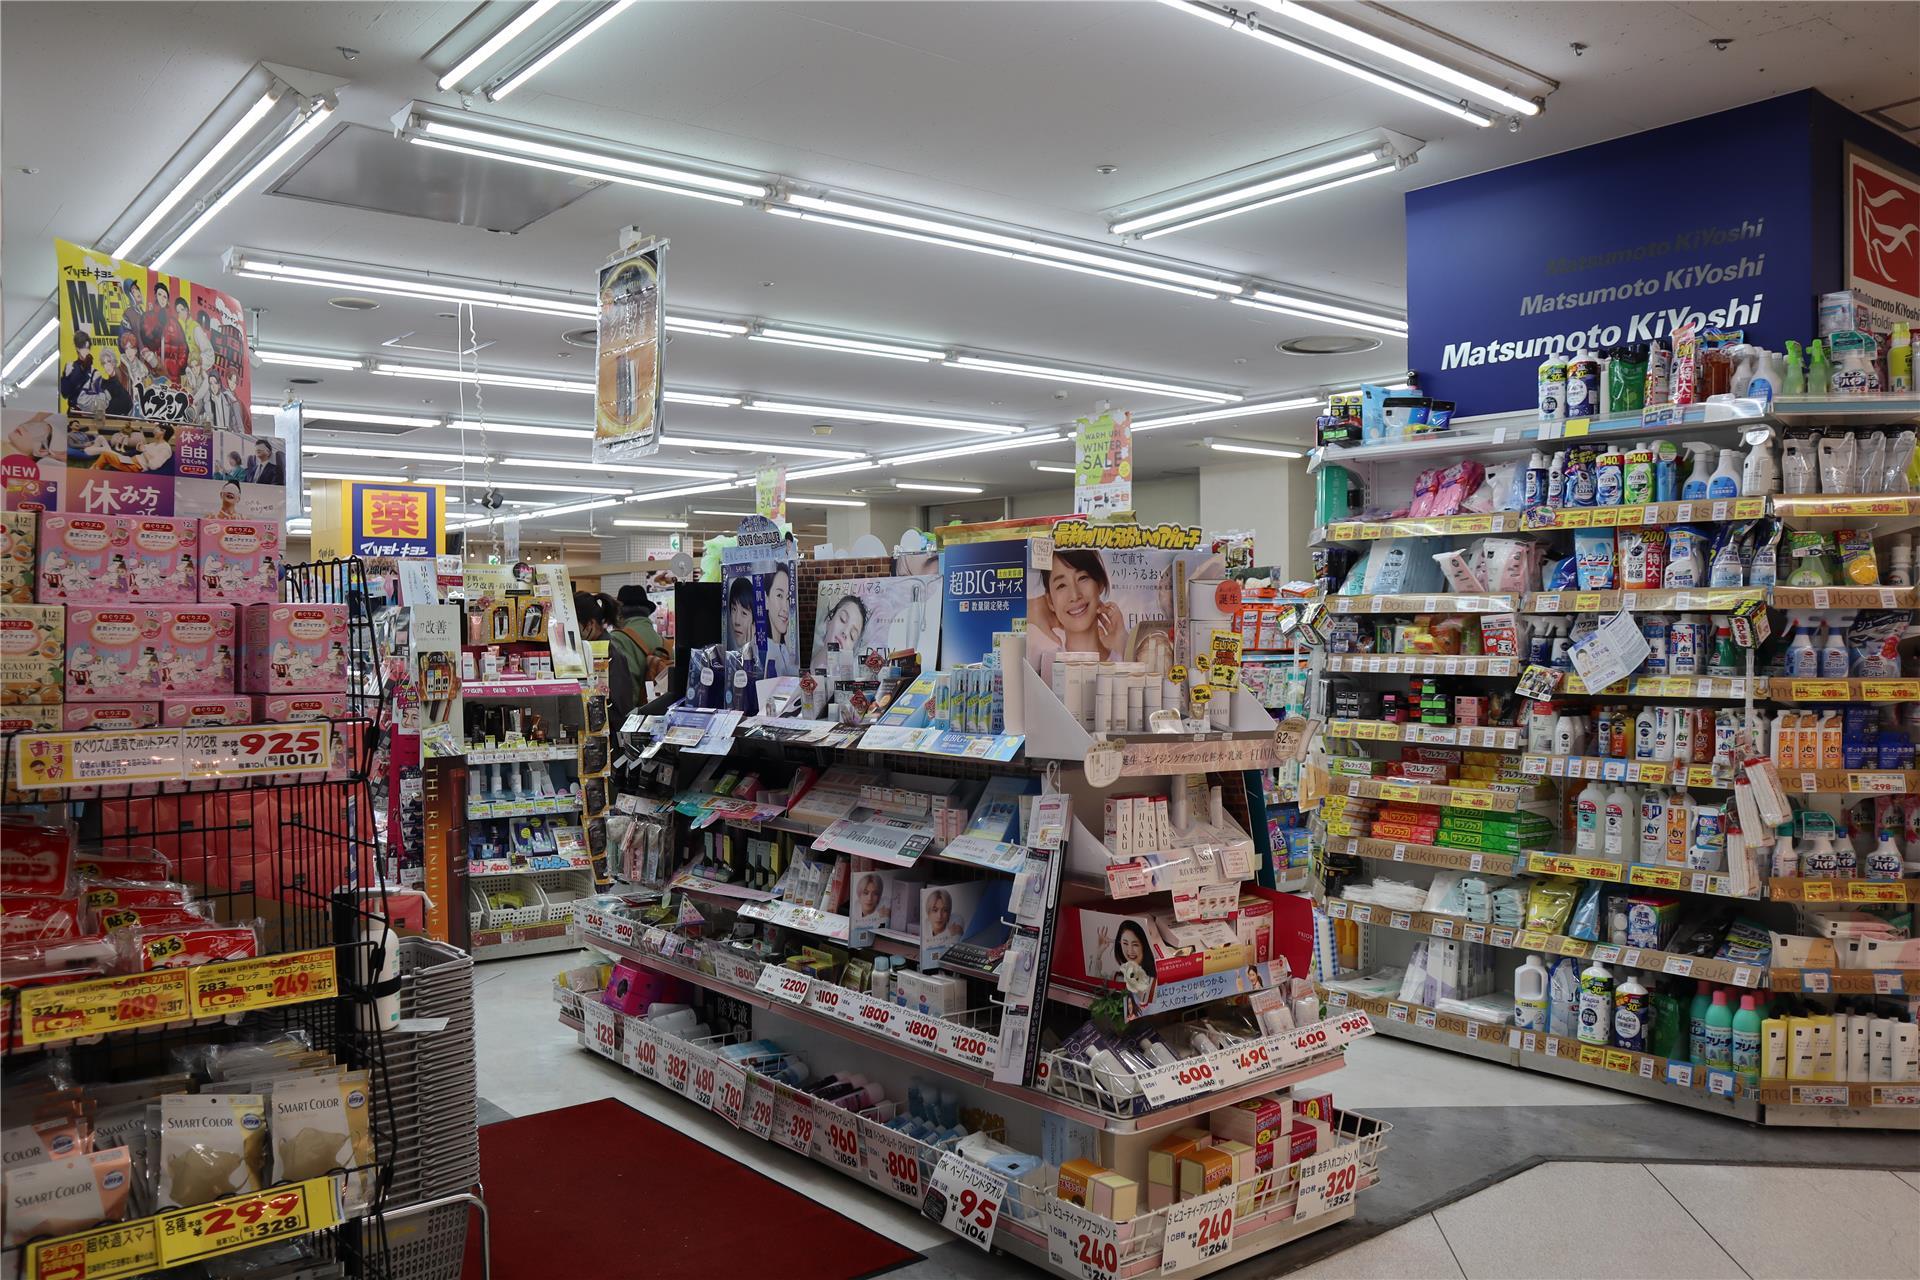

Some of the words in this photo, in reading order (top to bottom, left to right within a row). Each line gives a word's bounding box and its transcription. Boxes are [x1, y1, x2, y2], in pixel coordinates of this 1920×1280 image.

[1675, 217, 1764, 252] KiYoshi
[1520, 277, 1660, 317] Matsumoto
[1664, 254, 1766, 293] KiYoshi
[1441, 323, 1622, 372] Matsumoto
[1626, 294, 1764, 344] KiYoshi
[180, 446, 208, 460] 自由
[1084, 440, 1122, 453] WINTER
[1083, 452, 1122, 470] SALE
[1, 465, 38, 478] NEW
[80, 479, 160, 514] 休み方
[371, 492, 420, 536] 薬
[73, 521, 103, 530] めぐりズム
[143, 522, 172, 530] めぐりズム
[1643, 530, 1665, 544] 200
[360, 542, 428, 558] マツモトキヨシ
[1647, 552, 1660, 578] 特大
[101, 613, 132, 622] めぐりズム
[180, 614, 208, 622] めぐりズム
[296, 611, 322, 619] めぐりズム
[240, 731, 320, 756] 925
[426, 767, 439, 802] THE
[1384, 827, 1410, 836] サランラップ
[1456, 821, 1482, 830] サランラップ
[1643, 825, 1660, 836] JOY
[1668, 830, 1684, 840] JOY
[847, 830, 898, 850] Primavista
[1452, 834, 1481, 844] サランラップ
[108, 913, 136, 927] 貼る
[588, 914, 603, 927] 245
[618, 925, 633, 938] 800
[152, 938, 182, 957] 貼る
[270, 962, 332, 976] ホカロン貼るミニ
[736, 966, 754, 981] 1800
[199, 982, 228, 993] 283
[274, 972, 309, 998] 249
[783, 978, 808, 995] 2200
[118, 994, 158, 1020] 289
[818, 990, 839, 1006] 1100
[1160, 988, 1224, 1009] 大人のオールインワン
[33, 1005, 64, 1016] 327
[863, 1004, 890, 1024] 1800
[597, 1022, 614, 1046] 128
[908, 1020, 938, 1042] 1800
[1342, 1016, 1369, 1034] 980
[956, 1035, 986, 1057] 1200
[1298, 1030, 1326, 1050] 400
[638, 1040, 656, 1066] 400
[1241, 1046, 1269, 1068] 490
[668, 1054, 688, 1082] 382
[1178, 1064, 1213, 1086] 600
[696, 1066, 715, 1094] 480
[278, 1102, 308, 1115] SMART
[309, 1096, 339, 1111] COLOR
[725, 1083, 742, 1111] 780
[168, 1118, 201, 1130] SMART
[201, 1116, 234, 1128] COLOR
[753, 1101, 772, 1127] 298
[791, 1115, 812, 1142] 398
[830, 1124, 857, 1156] 960
[2, 1146, 41, 1164] COLOR
[1318, 1152, 1352, 1173] お手入れコットン
[888, 1152, 918, 1184] 800
[951, 1165, 1002, 1200] ペーパーハンドタオル
[1326, 1164, 1356, 1198] 320
[15, 1190, 56, 1208] SMART
[55, 1182, 92, 1200] COLOR
[1334, 1193, 1351, 1207] 352
[202, 1193, 300, 1236] 299
[960, 1190, 998, 1229] 95
[165, 1216, 186, 1236] 各種
[256, 1216, 298, 1238] 328
[966, 1224, 986, 1244] 104
[1198, 1208, 1232, 1248] 240
[1078, 1234, 1118, 1274] 240
[1209, 1240, 1228, 1257] 264
